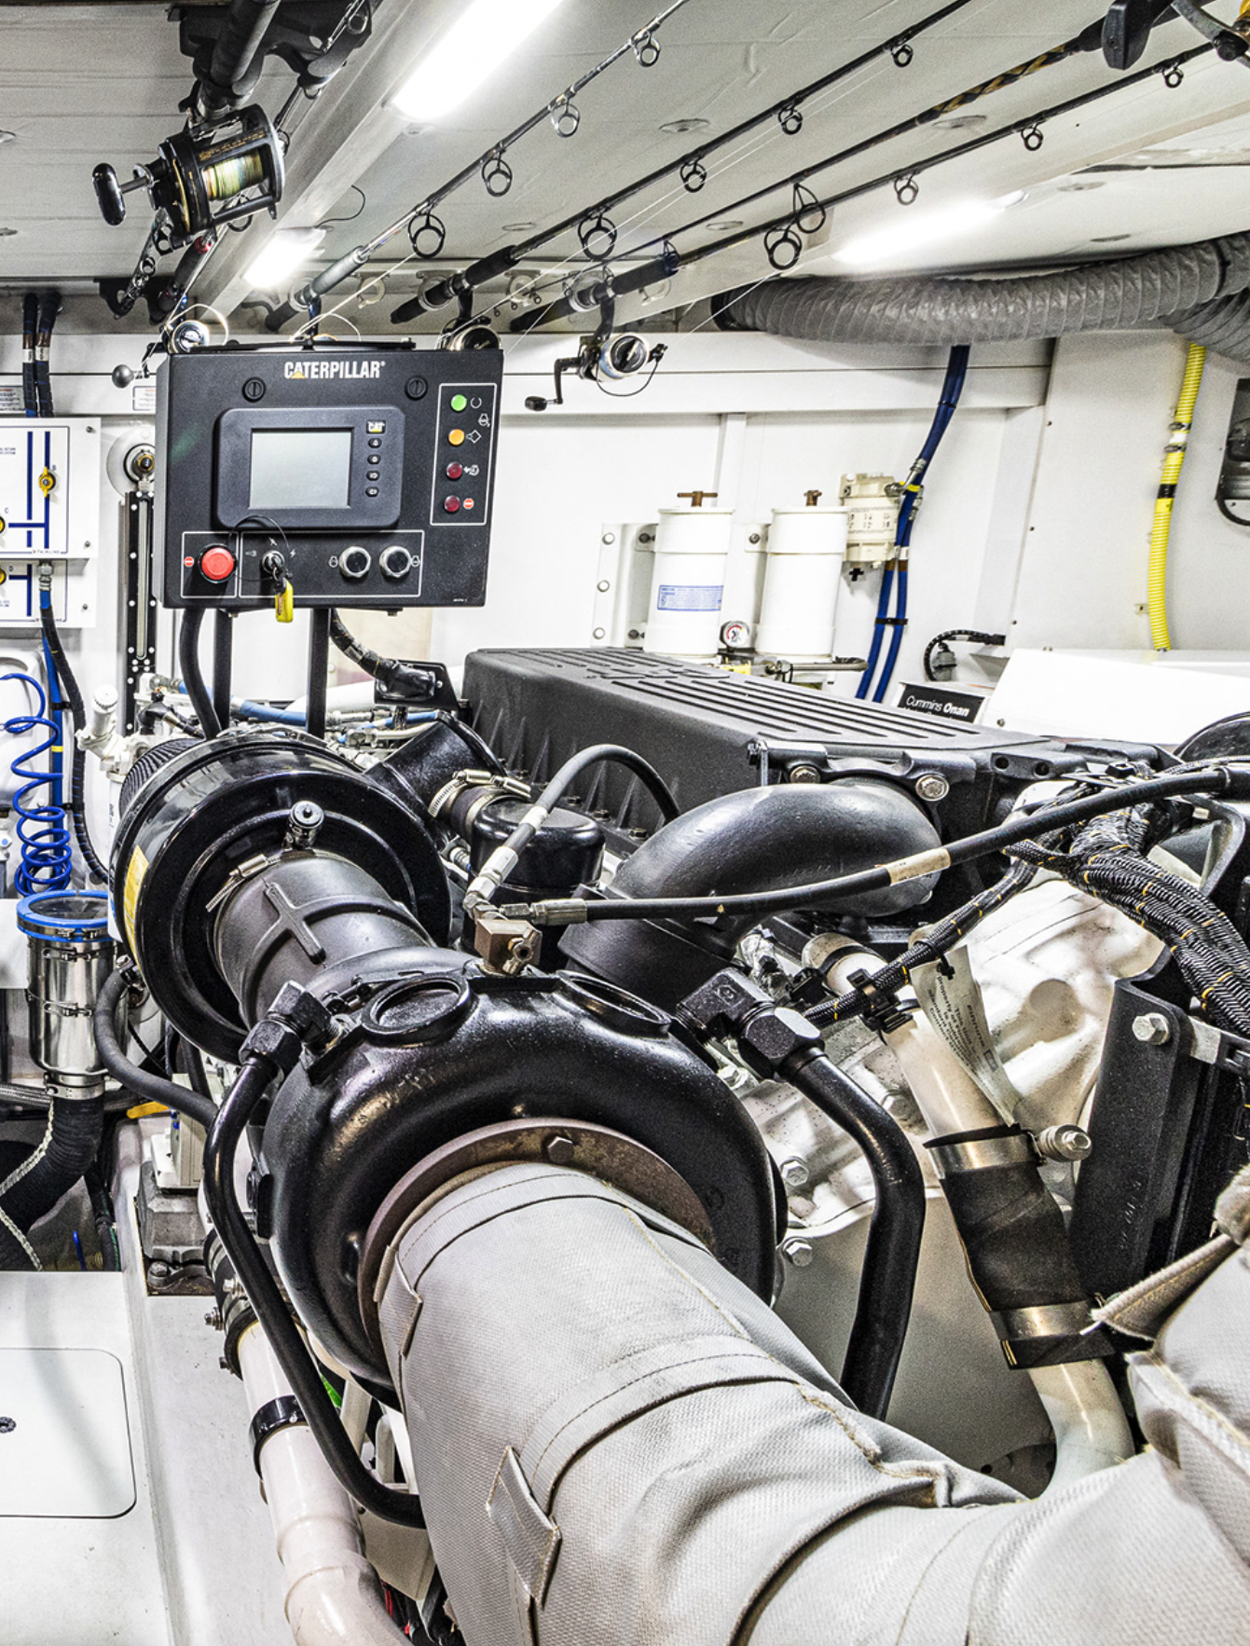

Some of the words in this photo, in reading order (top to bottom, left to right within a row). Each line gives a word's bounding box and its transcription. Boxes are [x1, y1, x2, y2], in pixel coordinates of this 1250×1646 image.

[284, 361, 381, 379] CATERPILLAR
[368, 421, 385, 433] CAT
[906, 694, 942, 711] Cummins
[943, 703, 970, 717] Onan
